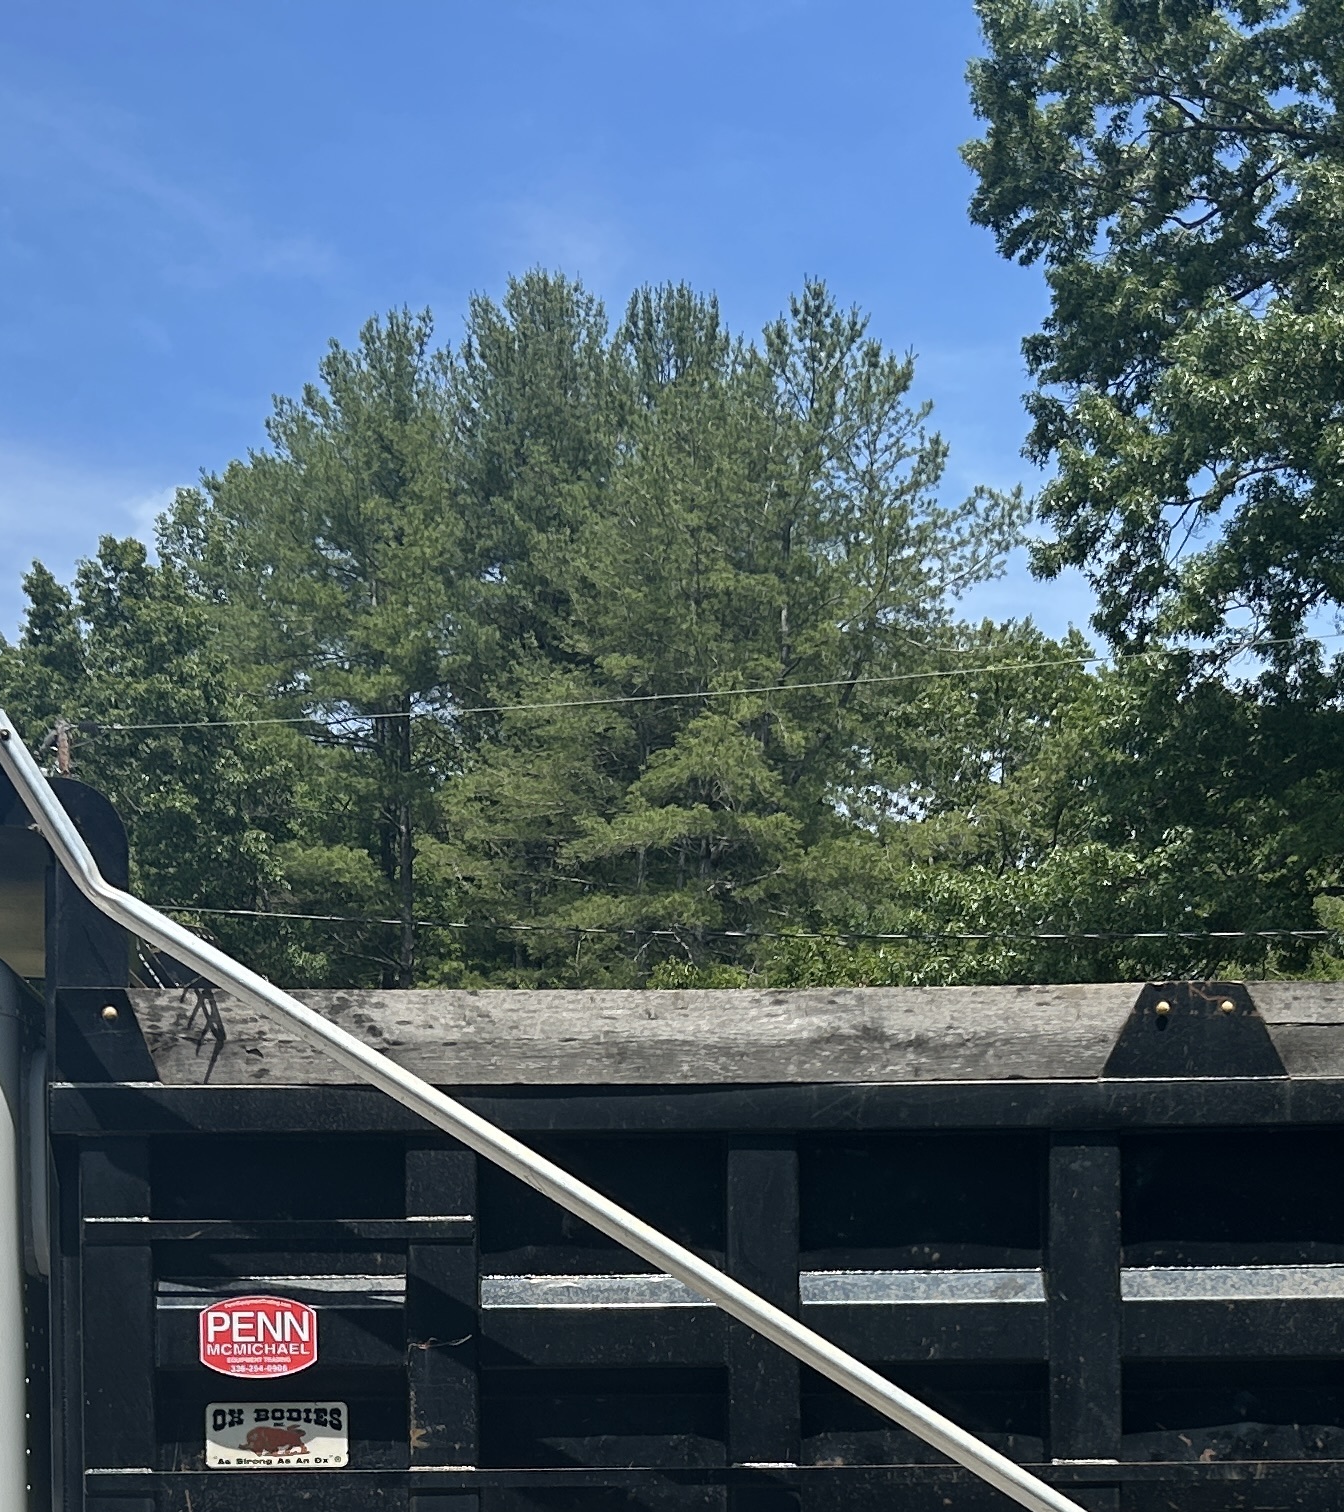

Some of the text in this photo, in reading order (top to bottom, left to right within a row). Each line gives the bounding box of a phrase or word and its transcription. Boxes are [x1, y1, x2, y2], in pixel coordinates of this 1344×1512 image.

[207, 1311, 310, 1342] PENN
[206, 1343, 310, 1355] MCMICHAEL
[212, 1407, 343, 1431] OX BODIES
[236, 1457, 272, 1466] Strong
[277, 1457, 291, 1465] As
